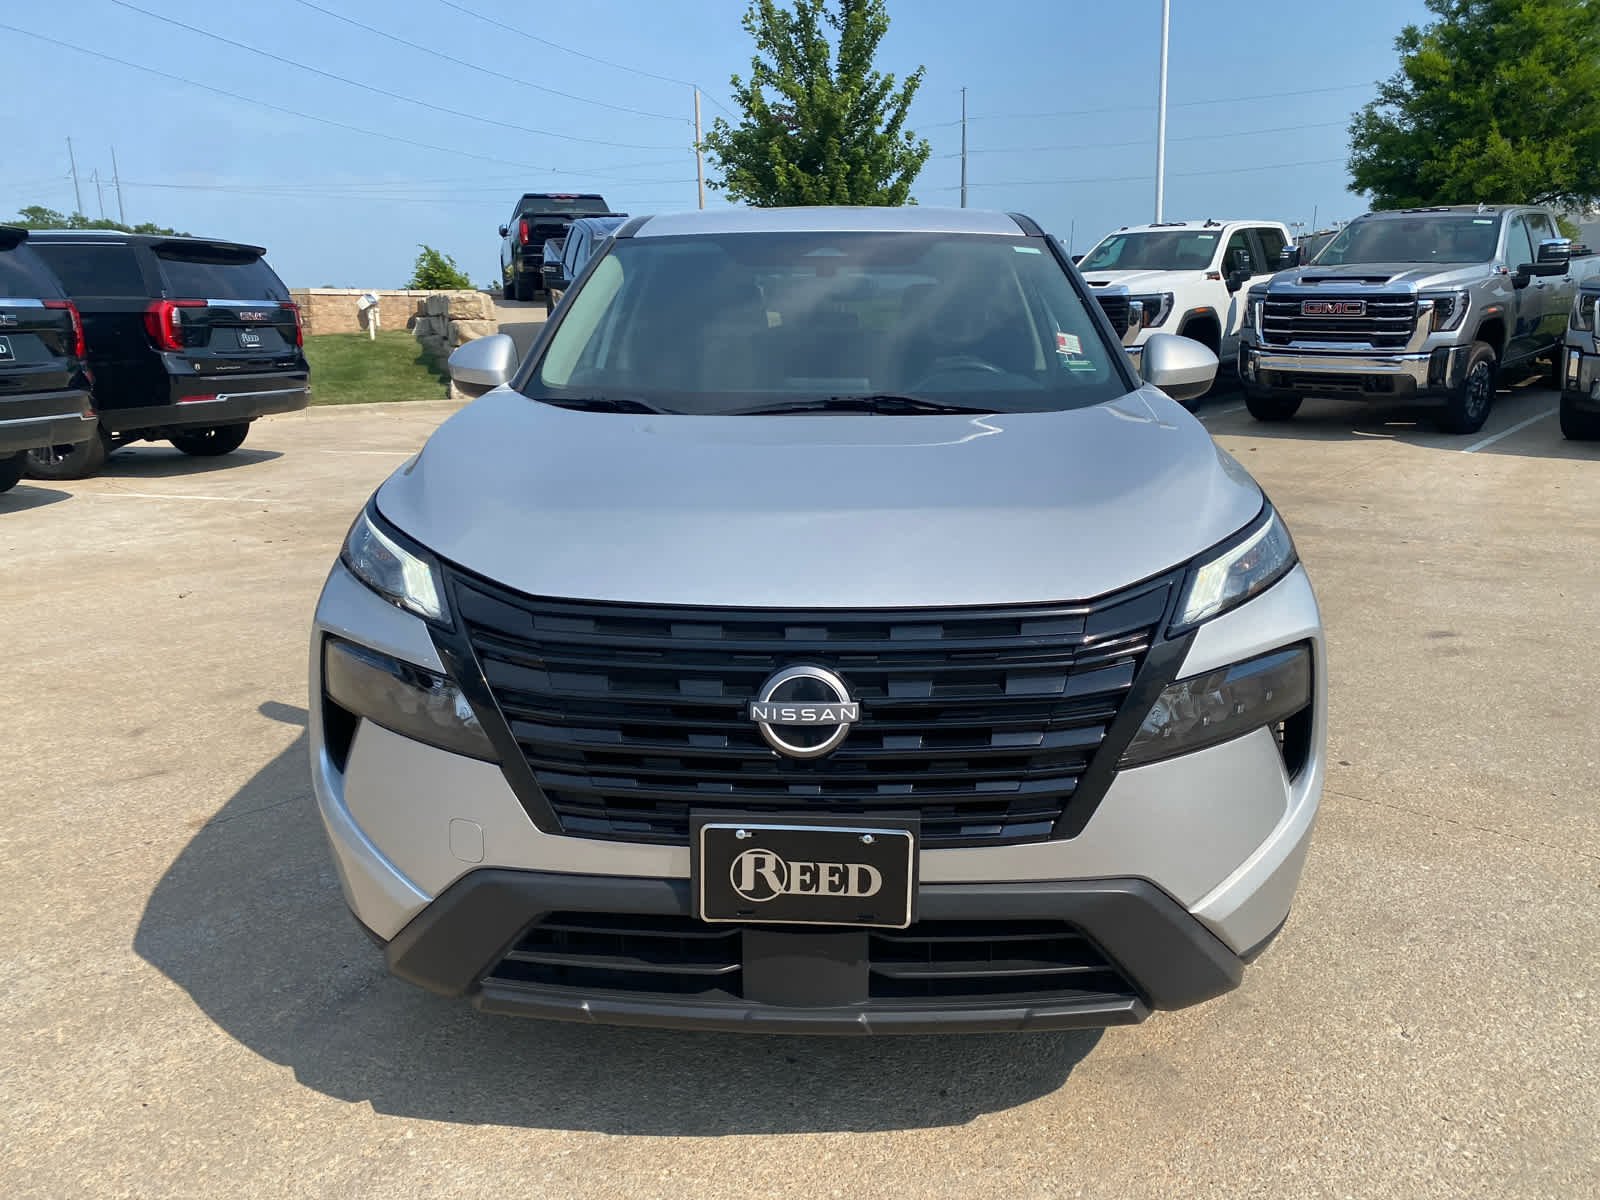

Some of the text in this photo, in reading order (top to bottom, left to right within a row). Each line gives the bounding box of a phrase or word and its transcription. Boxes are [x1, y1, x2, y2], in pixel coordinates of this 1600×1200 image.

[1305, 303, 1361, 314] GMC
[752, 706, 857, 721] NISSAN
[730, 849, 883, 902] REED
